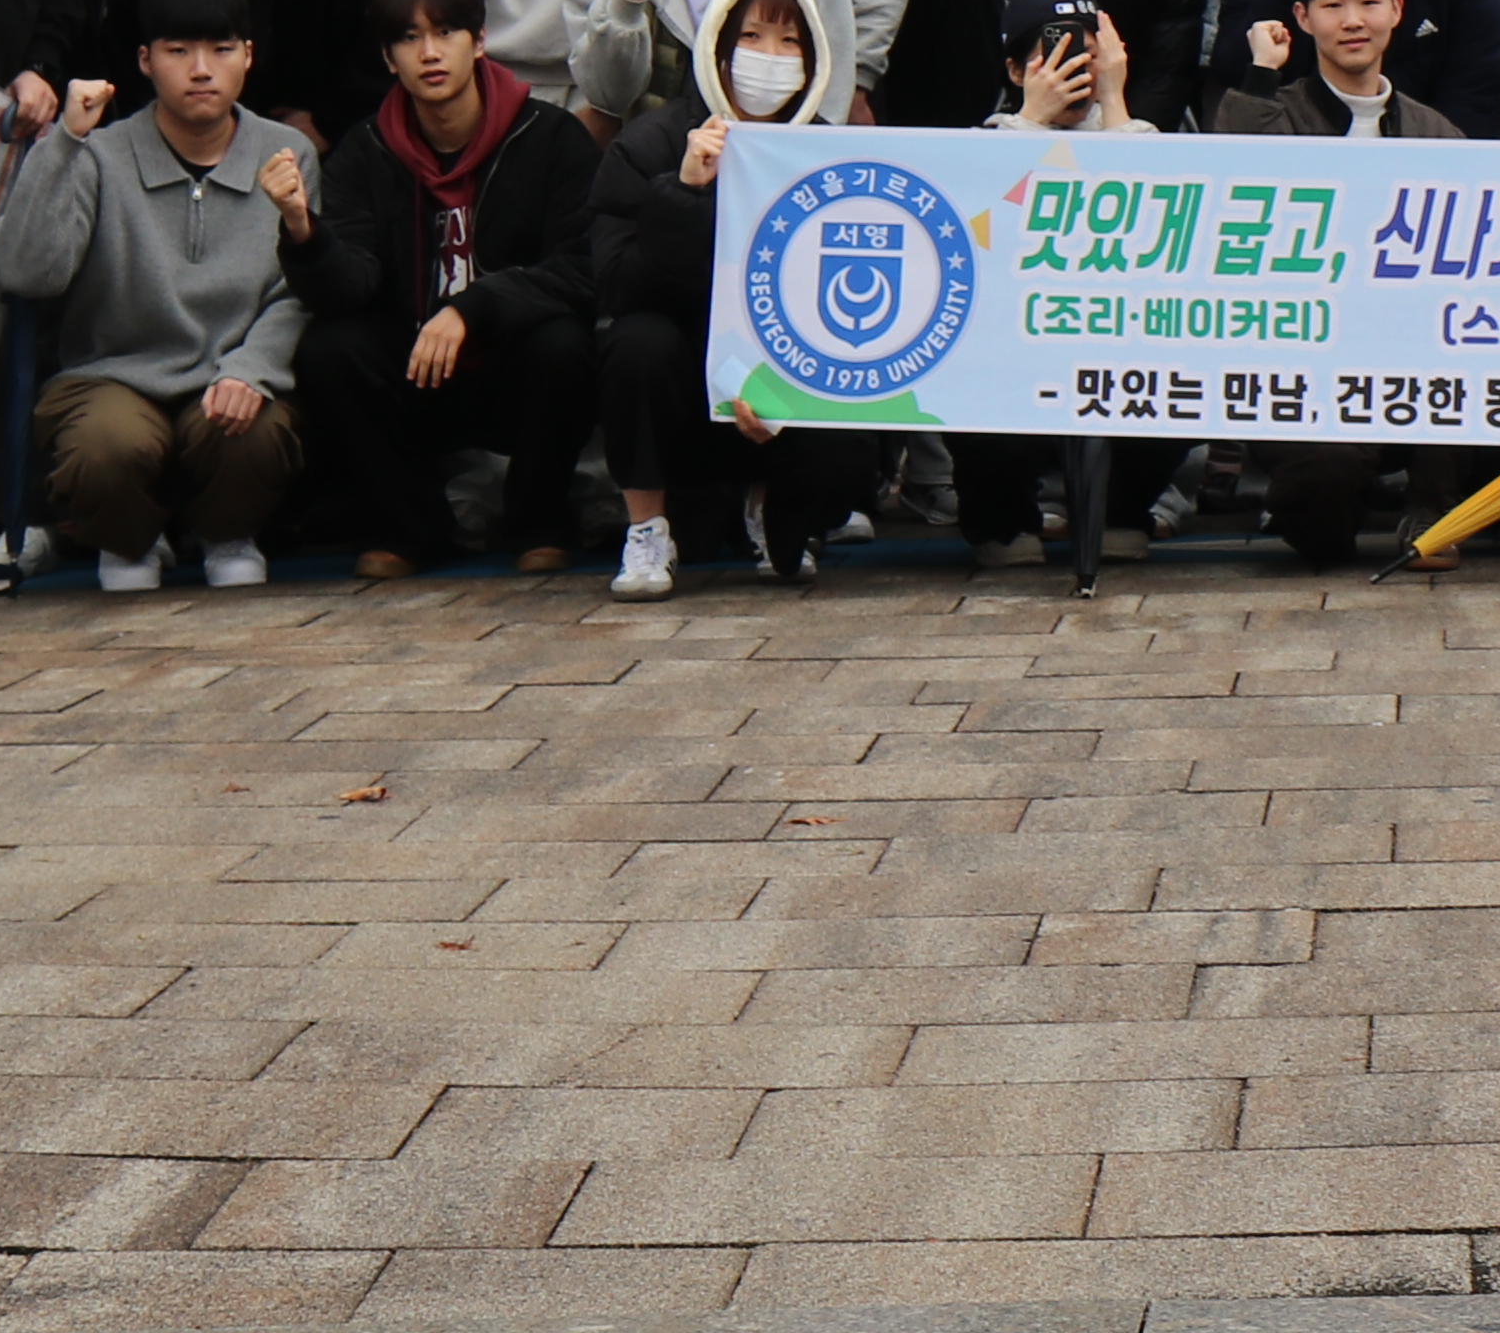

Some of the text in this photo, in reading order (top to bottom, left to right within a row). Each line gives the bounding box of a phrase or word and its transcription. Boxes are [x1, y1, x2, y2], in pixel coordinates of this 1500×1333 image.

[833, 224, 889, 249] 서영
[1019, 180, 1206, 274] 맛있게
[1213, 185, 1347, 284] 굽고,
[750, 270, 970, 391] SEOYEONG 1978 UNIVERSITY
[1076, 369, 1204, 420] 맛있는
[1223, 373, 1319, 424] 만남,
[1336, 375, 1468, 426] 건강한
